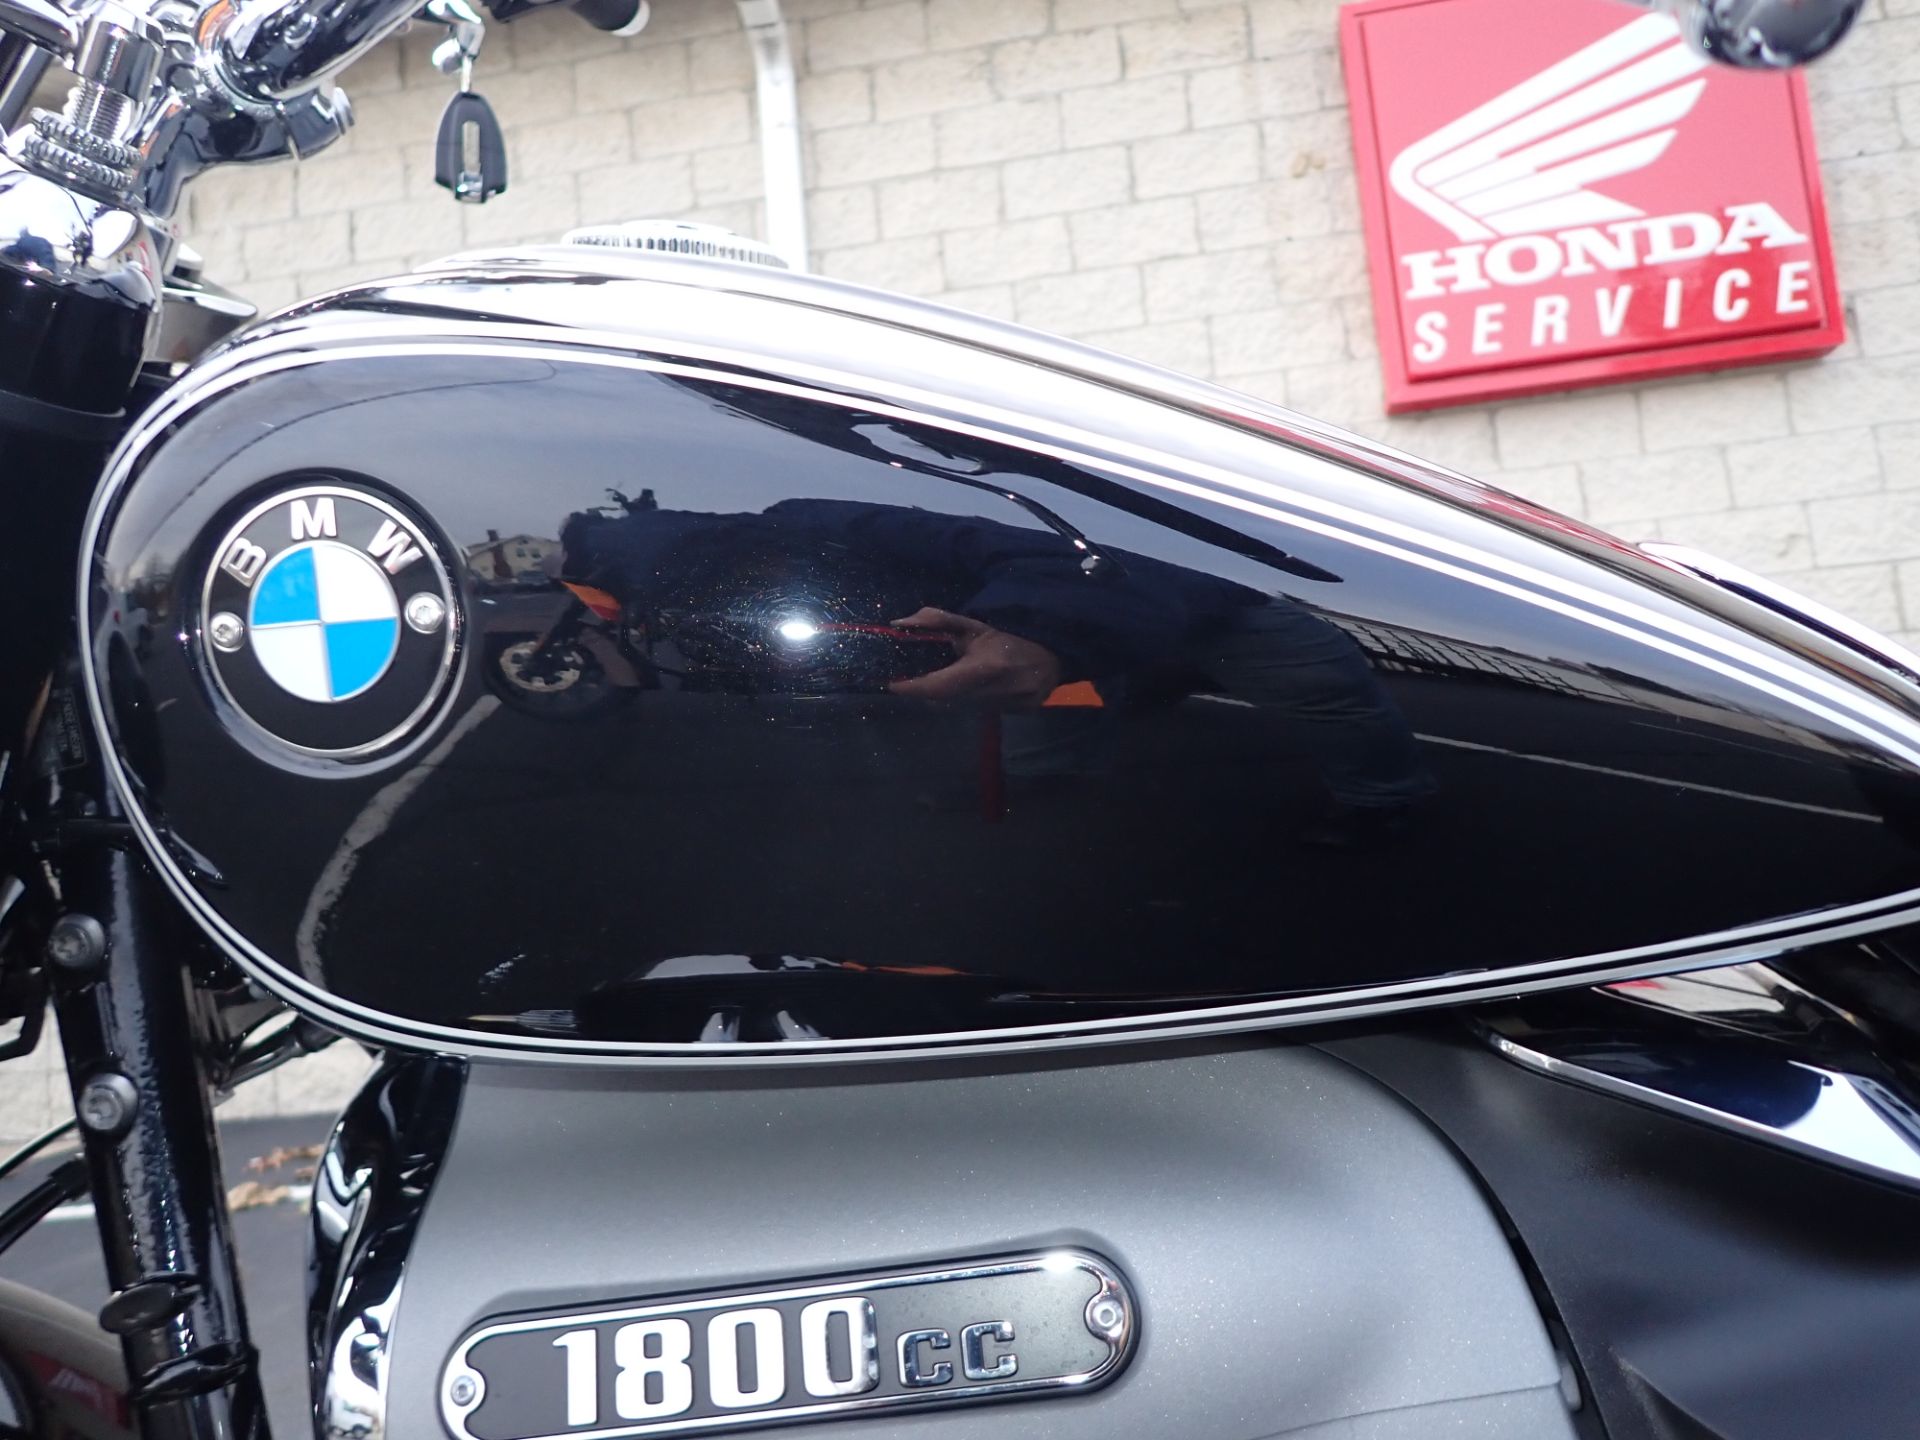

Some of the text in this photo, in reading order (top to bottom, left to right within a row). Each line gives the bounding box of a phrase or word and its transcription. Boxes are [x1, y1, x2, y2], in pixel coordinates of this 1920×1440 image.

[1401, 201, 1808, 299] HONDA
[1412, 261, 1812, 363] SERVICE
[220, 497, 424, 587] BMW
